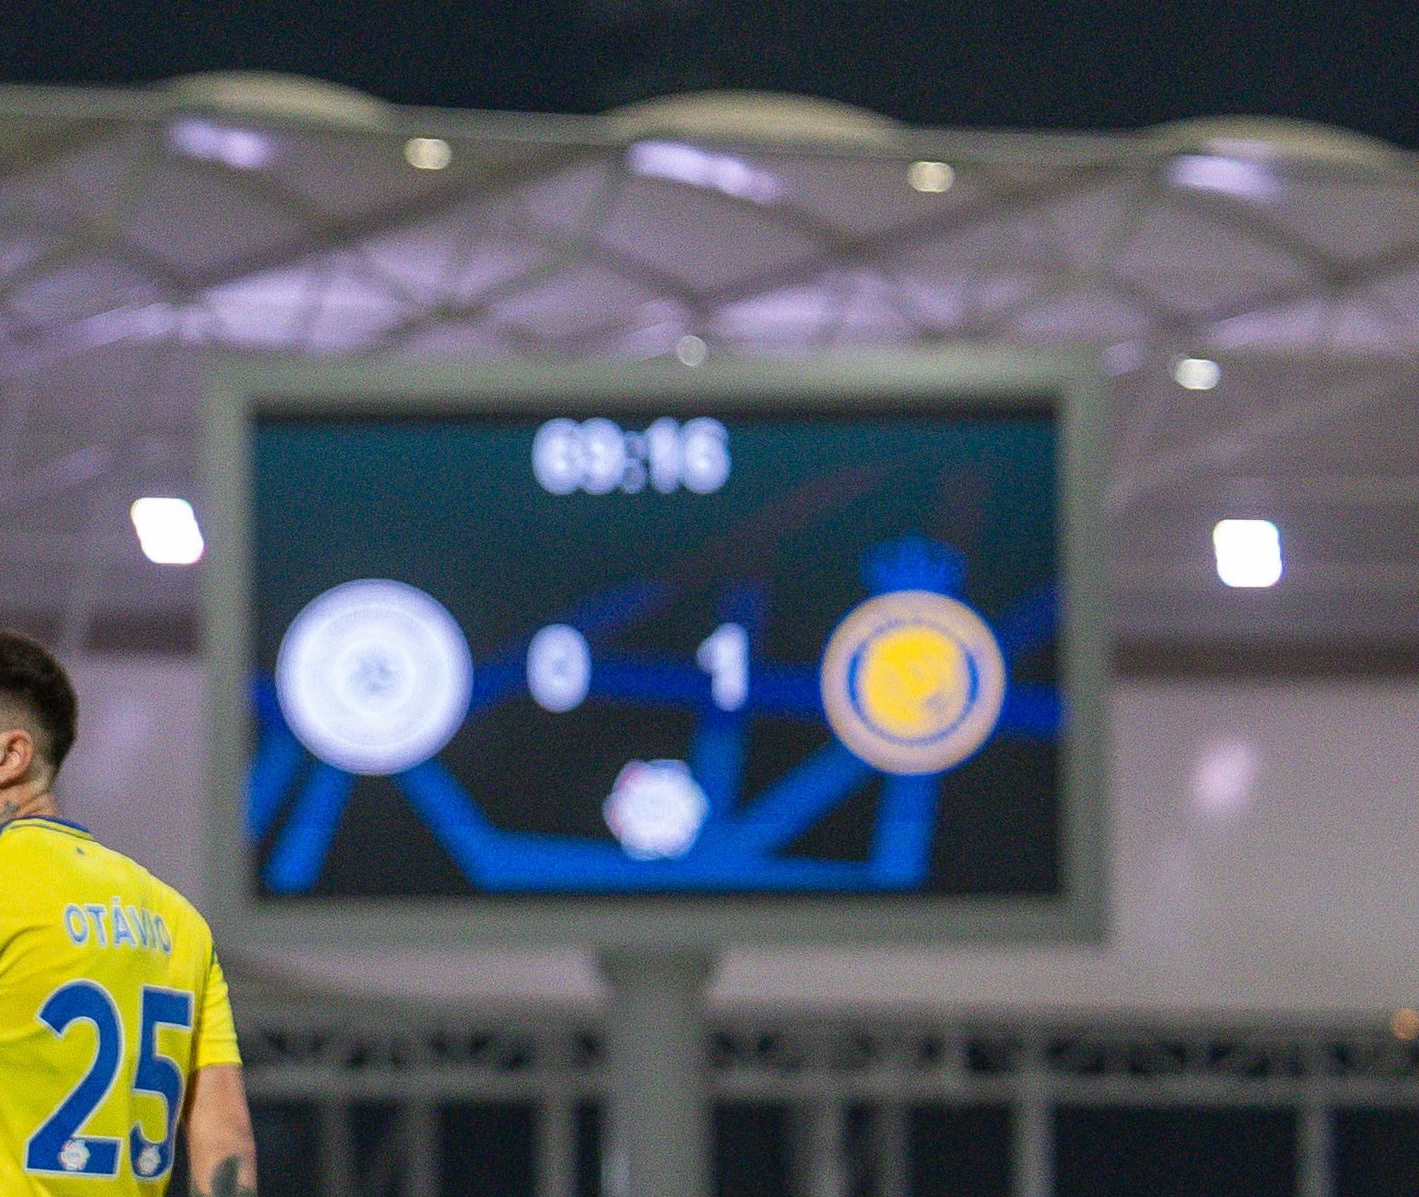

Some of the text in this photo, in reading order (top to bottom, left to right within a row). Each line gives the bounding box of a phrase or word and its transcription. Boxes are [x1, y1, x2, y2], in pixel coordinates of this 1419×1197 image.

[532, 416, 731, 495] 69:16
[526, 621, 751, 714] 0 1
[24, 978, 194, 1182] 25
